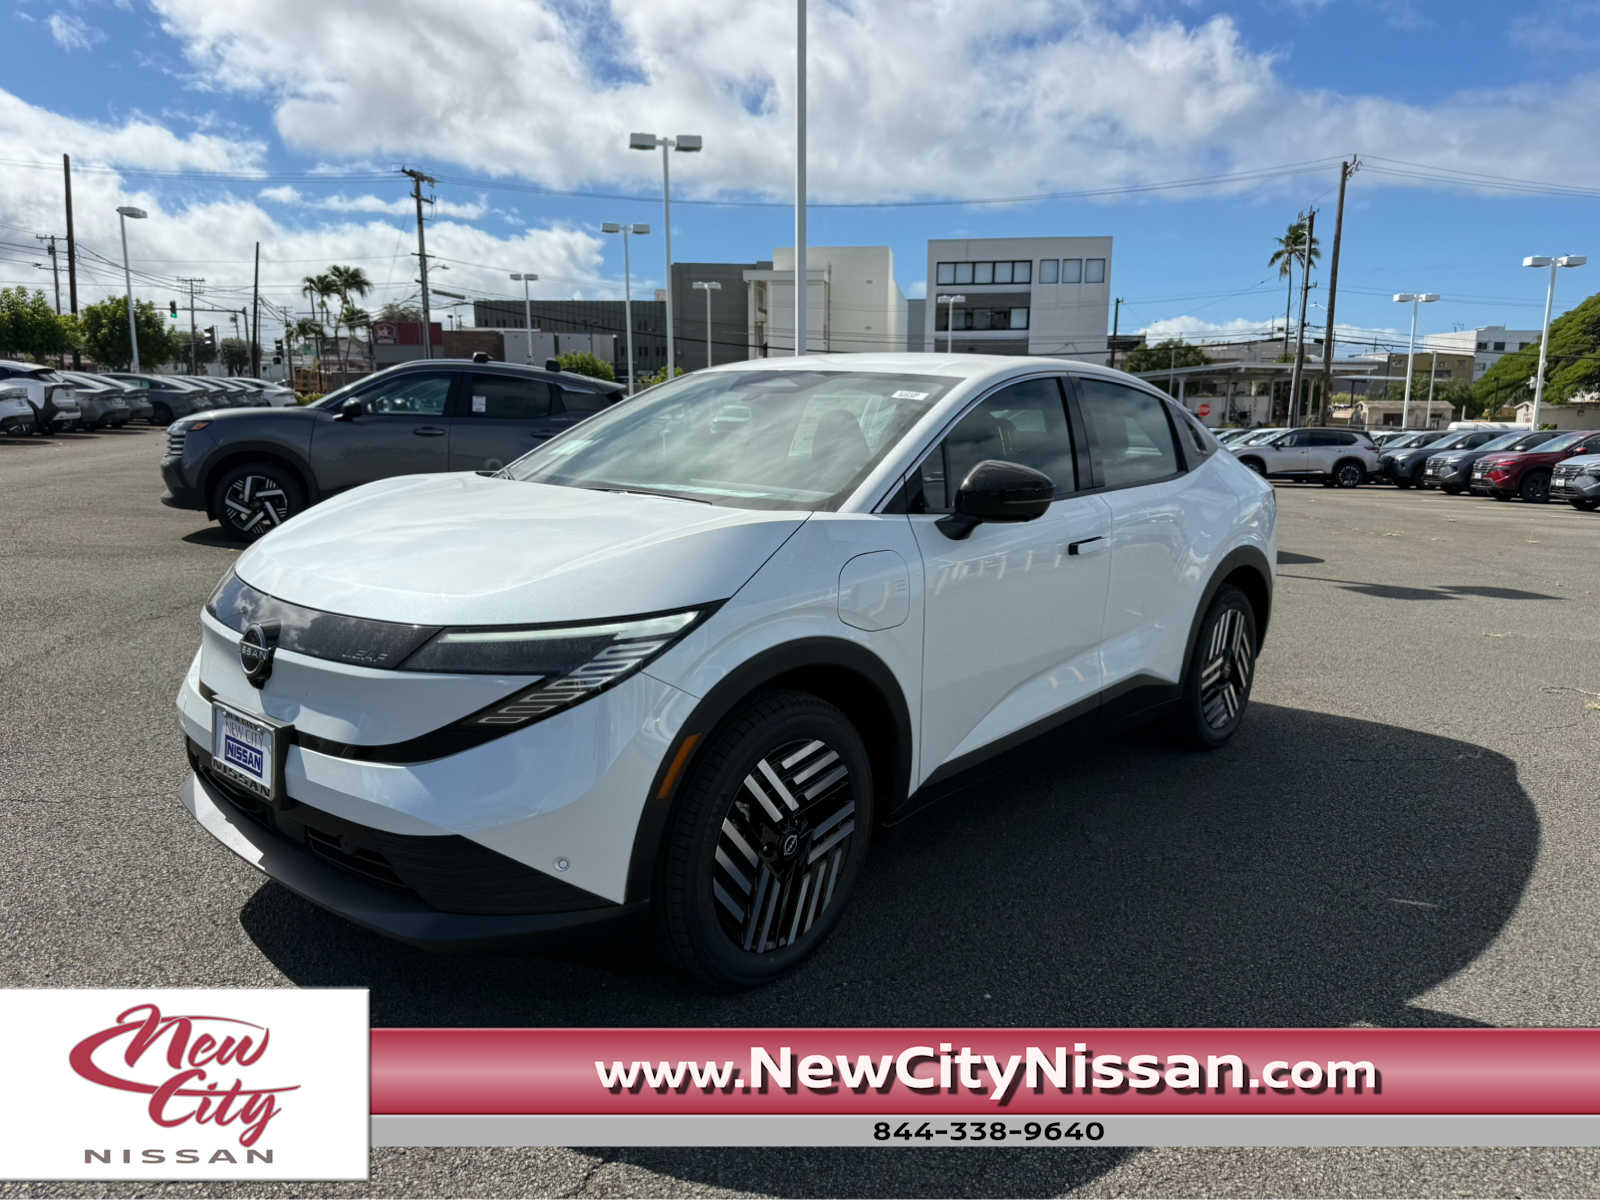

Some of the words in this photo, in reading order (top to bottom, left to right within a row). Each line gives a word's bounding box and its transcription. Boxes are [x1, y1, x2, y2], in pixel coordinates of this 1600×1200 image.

[225, 719, 244, 739] NEW
[226, 740, 262, 771] NISSAN
[212, 759, 271, 798] NISSAN
